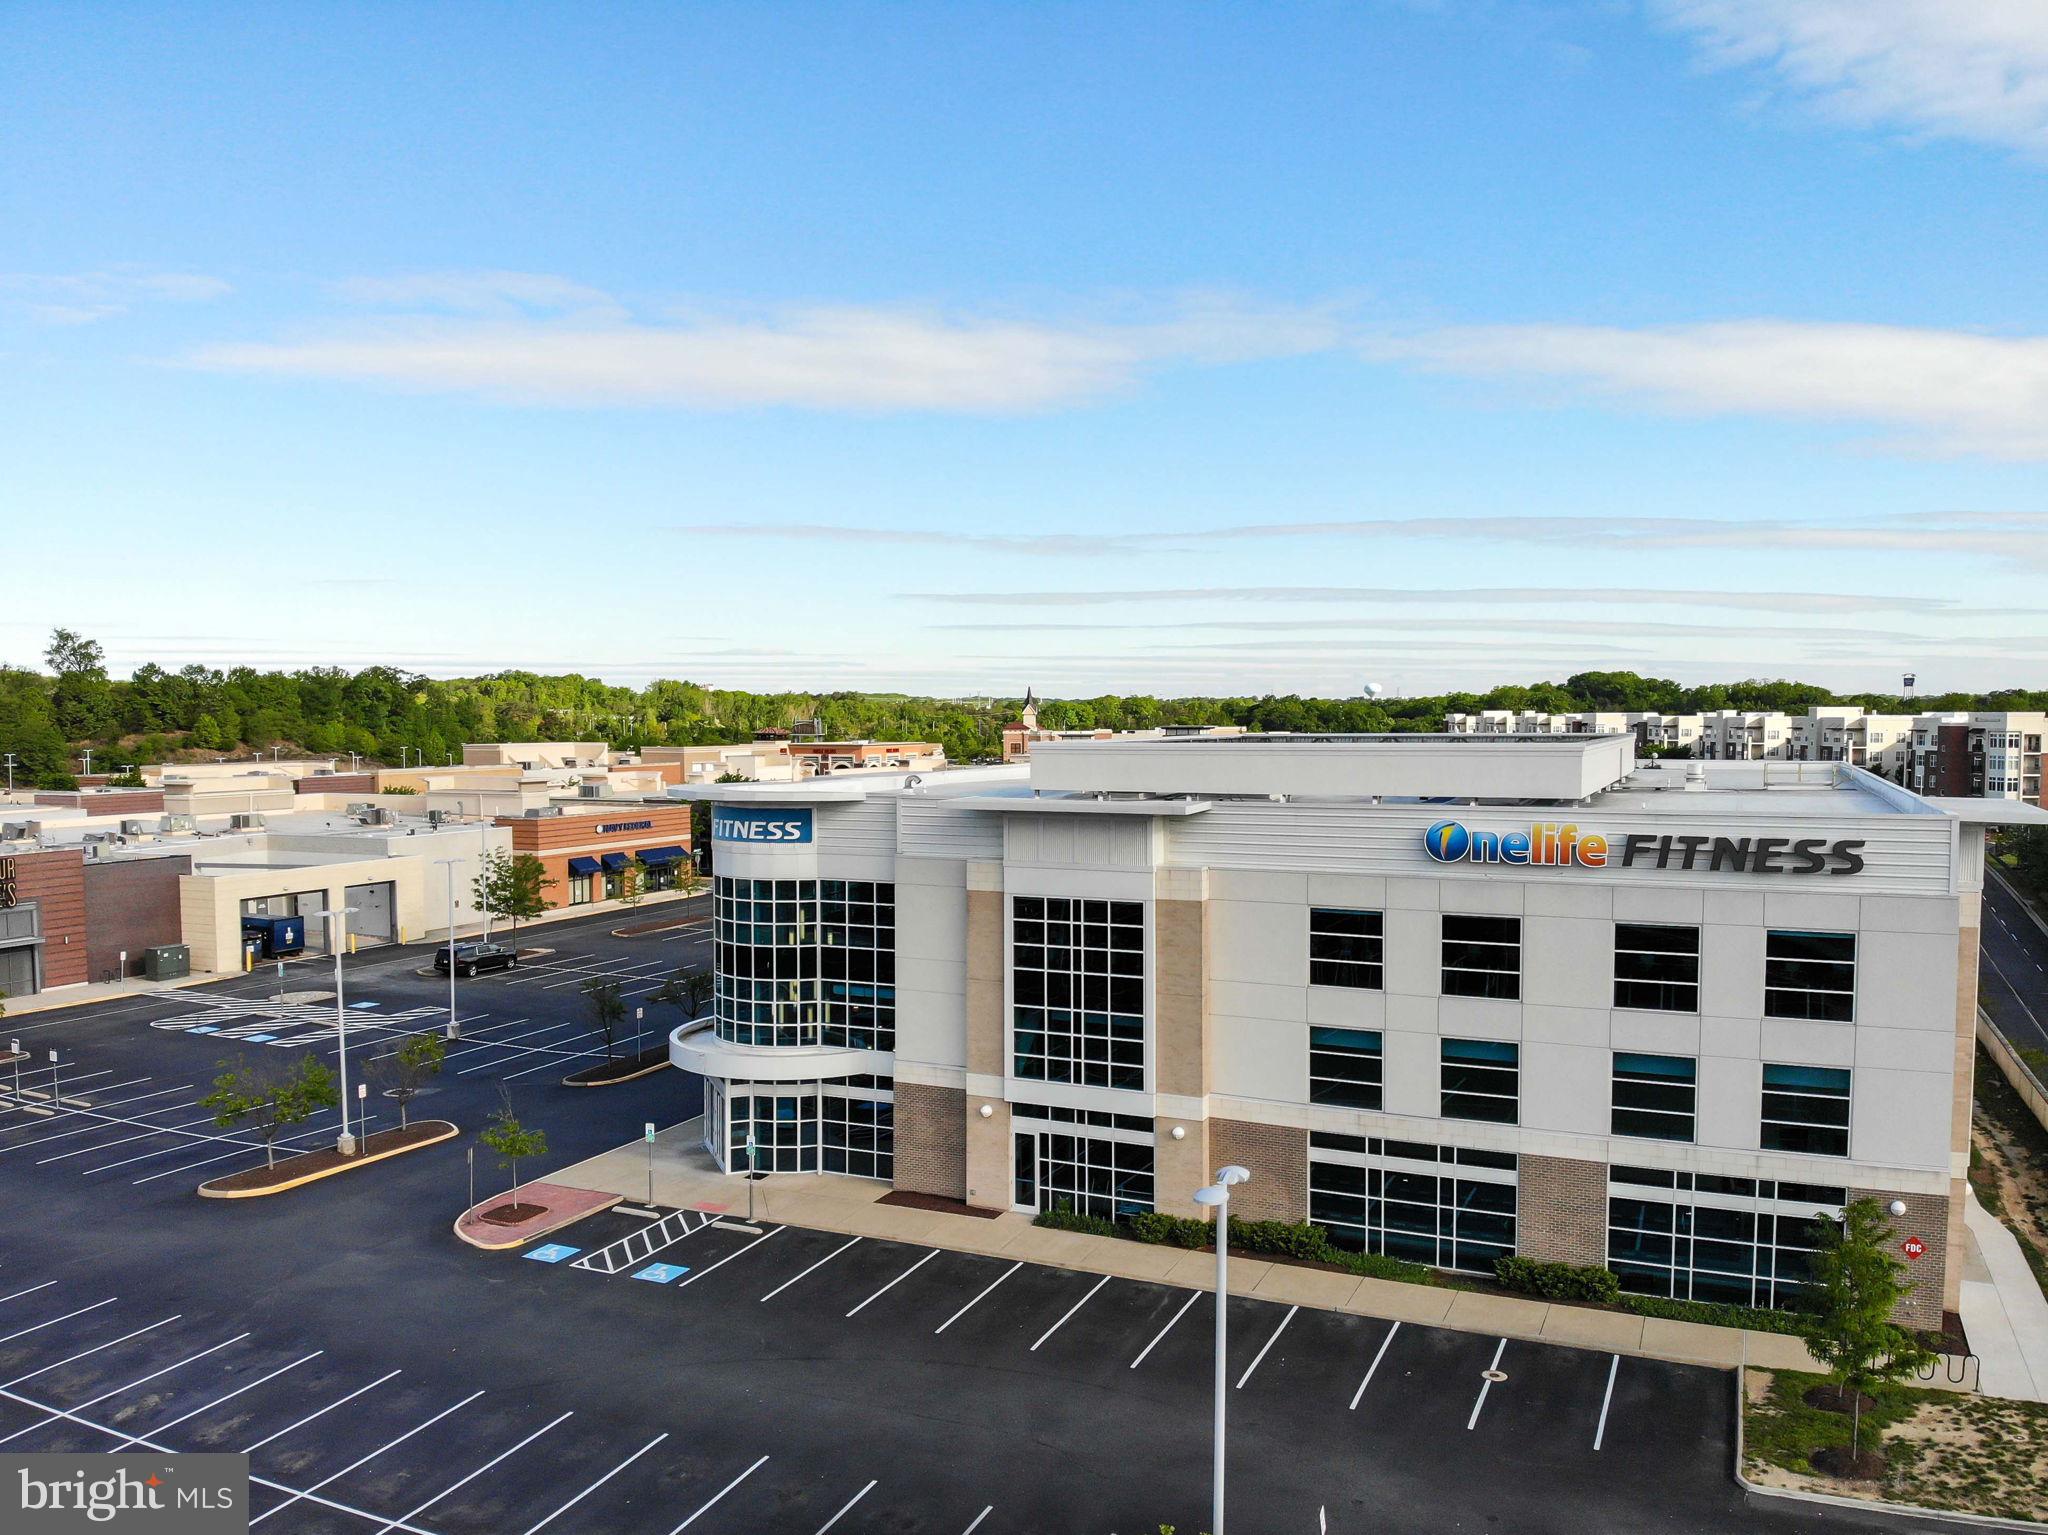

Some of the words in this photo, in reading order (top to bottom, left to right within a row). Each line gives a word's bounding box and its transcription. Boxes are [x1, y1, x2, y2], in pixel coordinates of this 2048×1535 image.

[713, 818, 801, 840] FITNESS
[1424, 819, 1608, 868] Onelife
[1621, 834, 1866, 875] FITNESS
[1905, 1243, 1922, 1253] FDC
